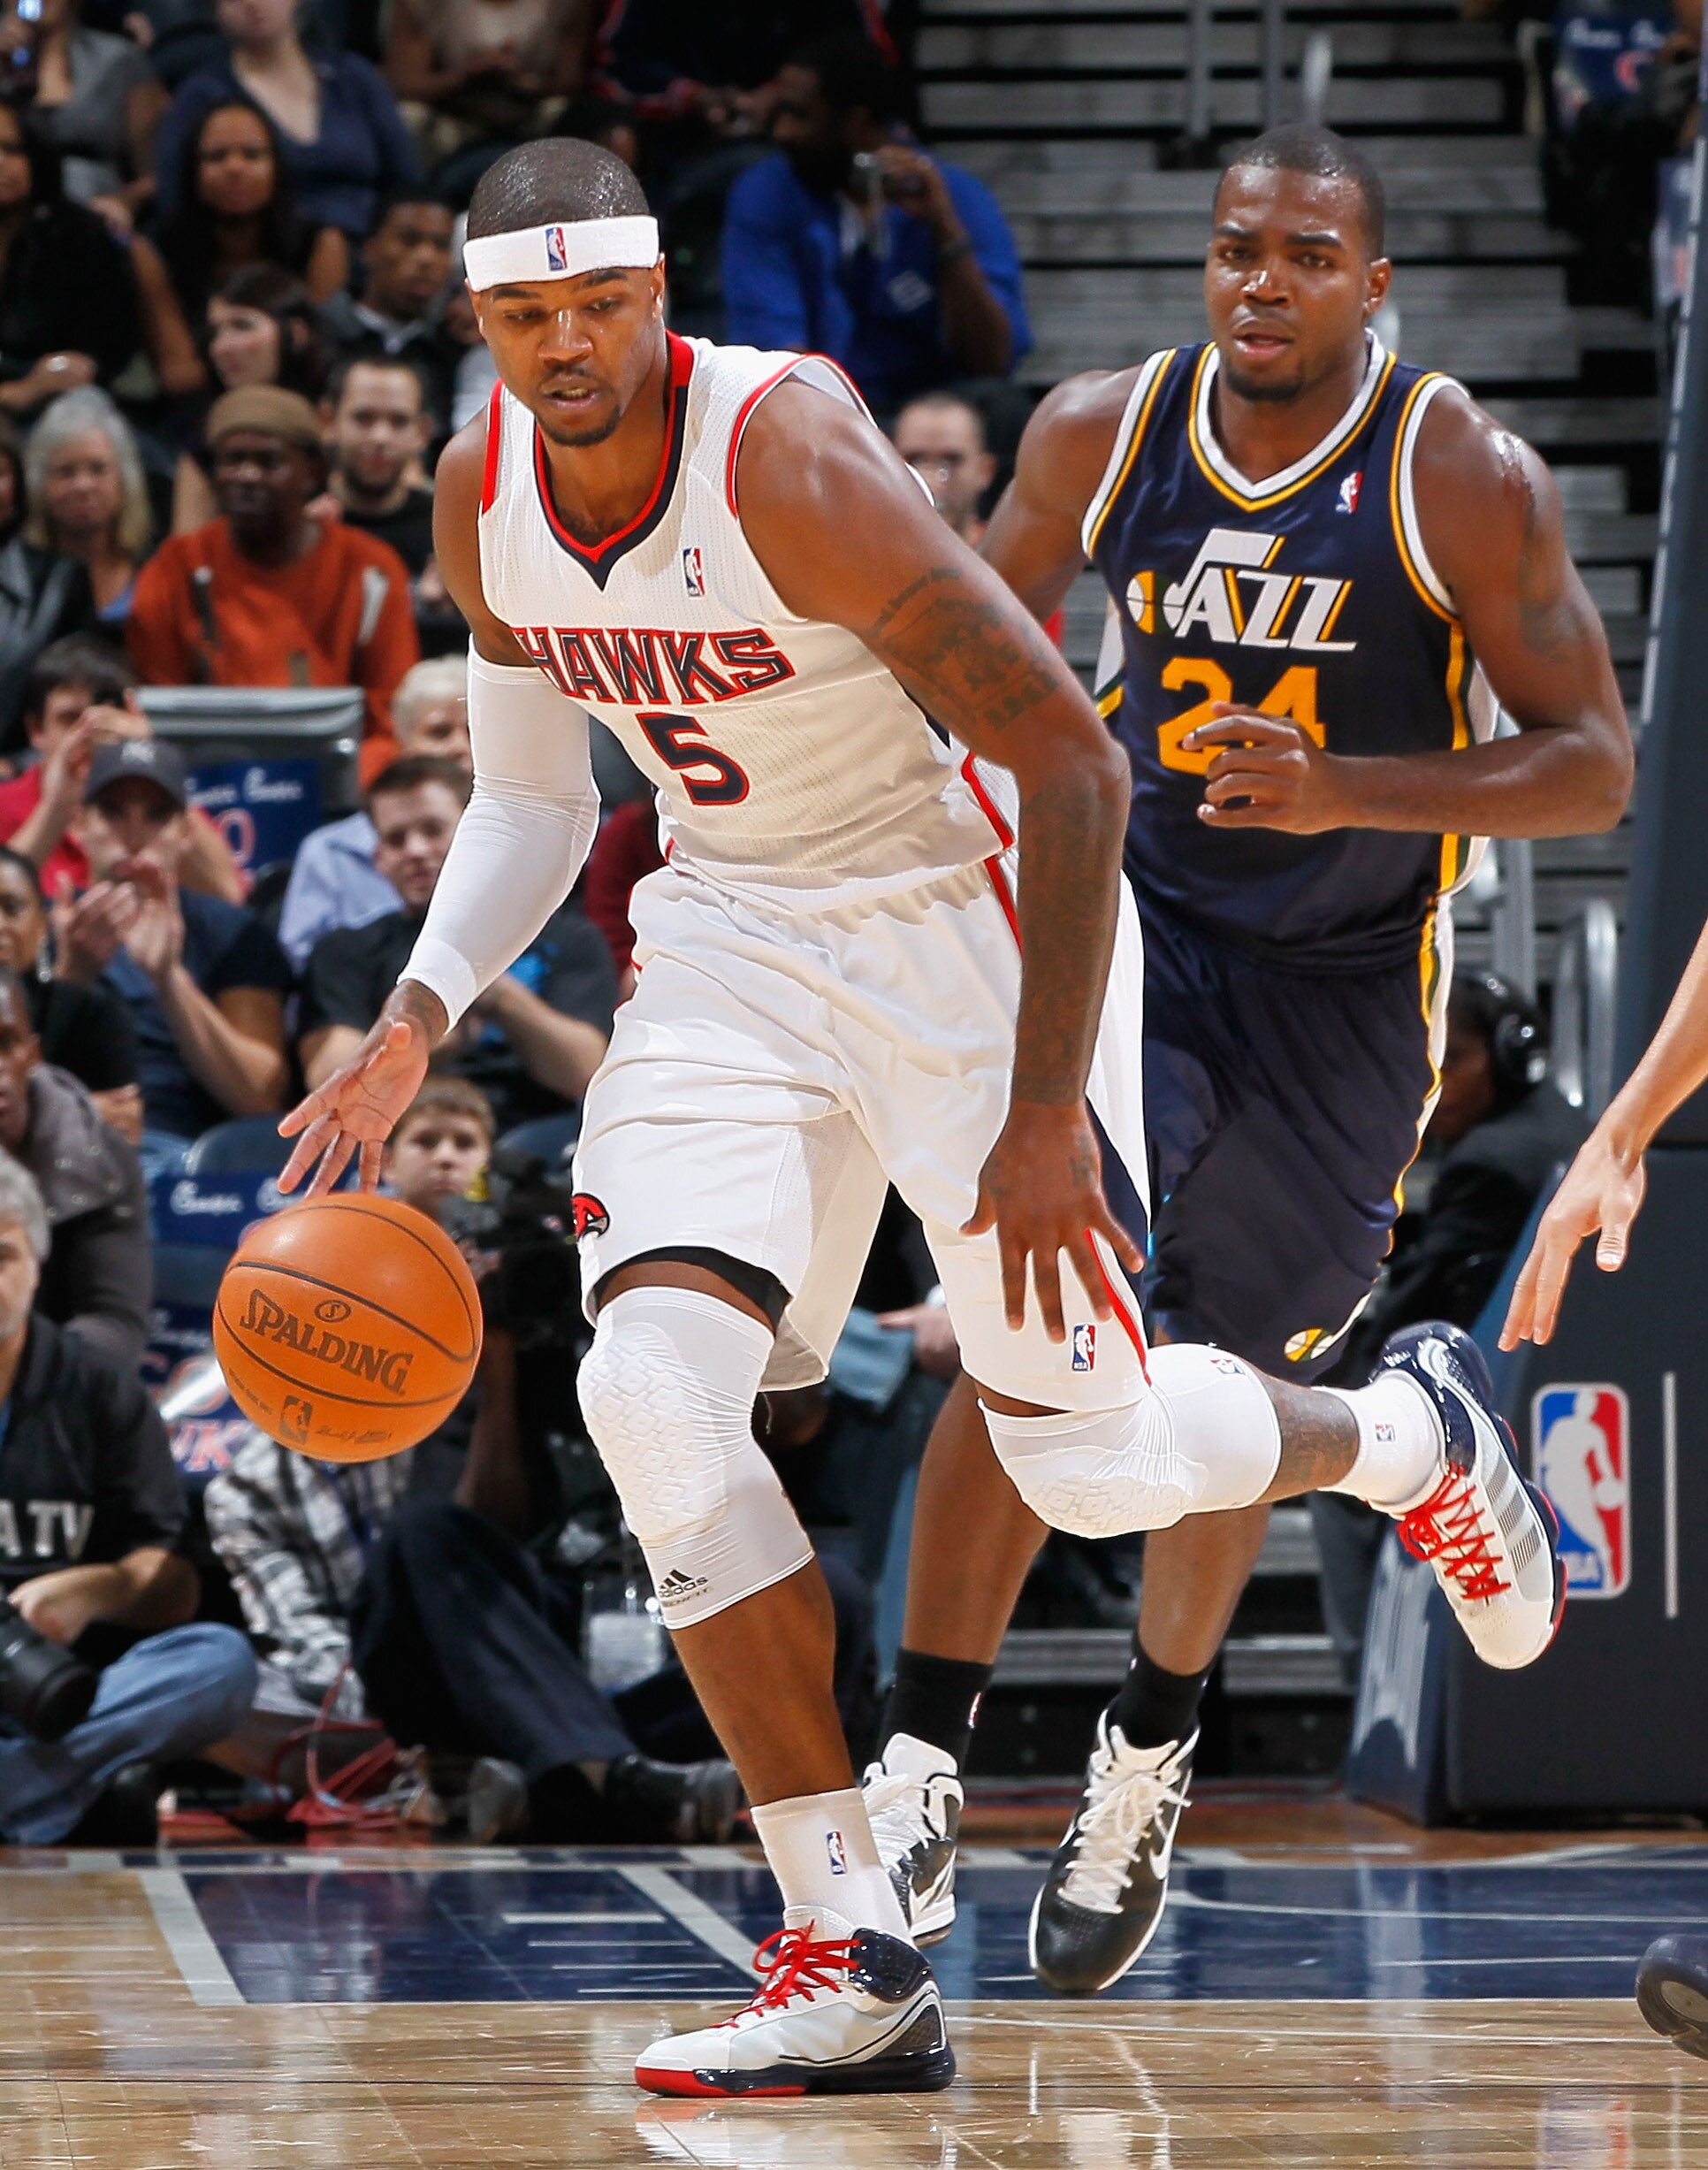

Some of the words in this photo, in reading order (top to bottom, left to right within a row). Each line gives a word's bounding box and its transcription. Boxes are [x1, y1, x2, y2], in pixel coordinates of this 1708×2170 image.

[1162, 528, 1357, 652] JAZZ
[510, 626, 797, 706] HAWKS
[1156, 656, 1327, 776] 24
[636, 711, 751, 806] 5
[239, 1288, 414, 1395] SPALDING
